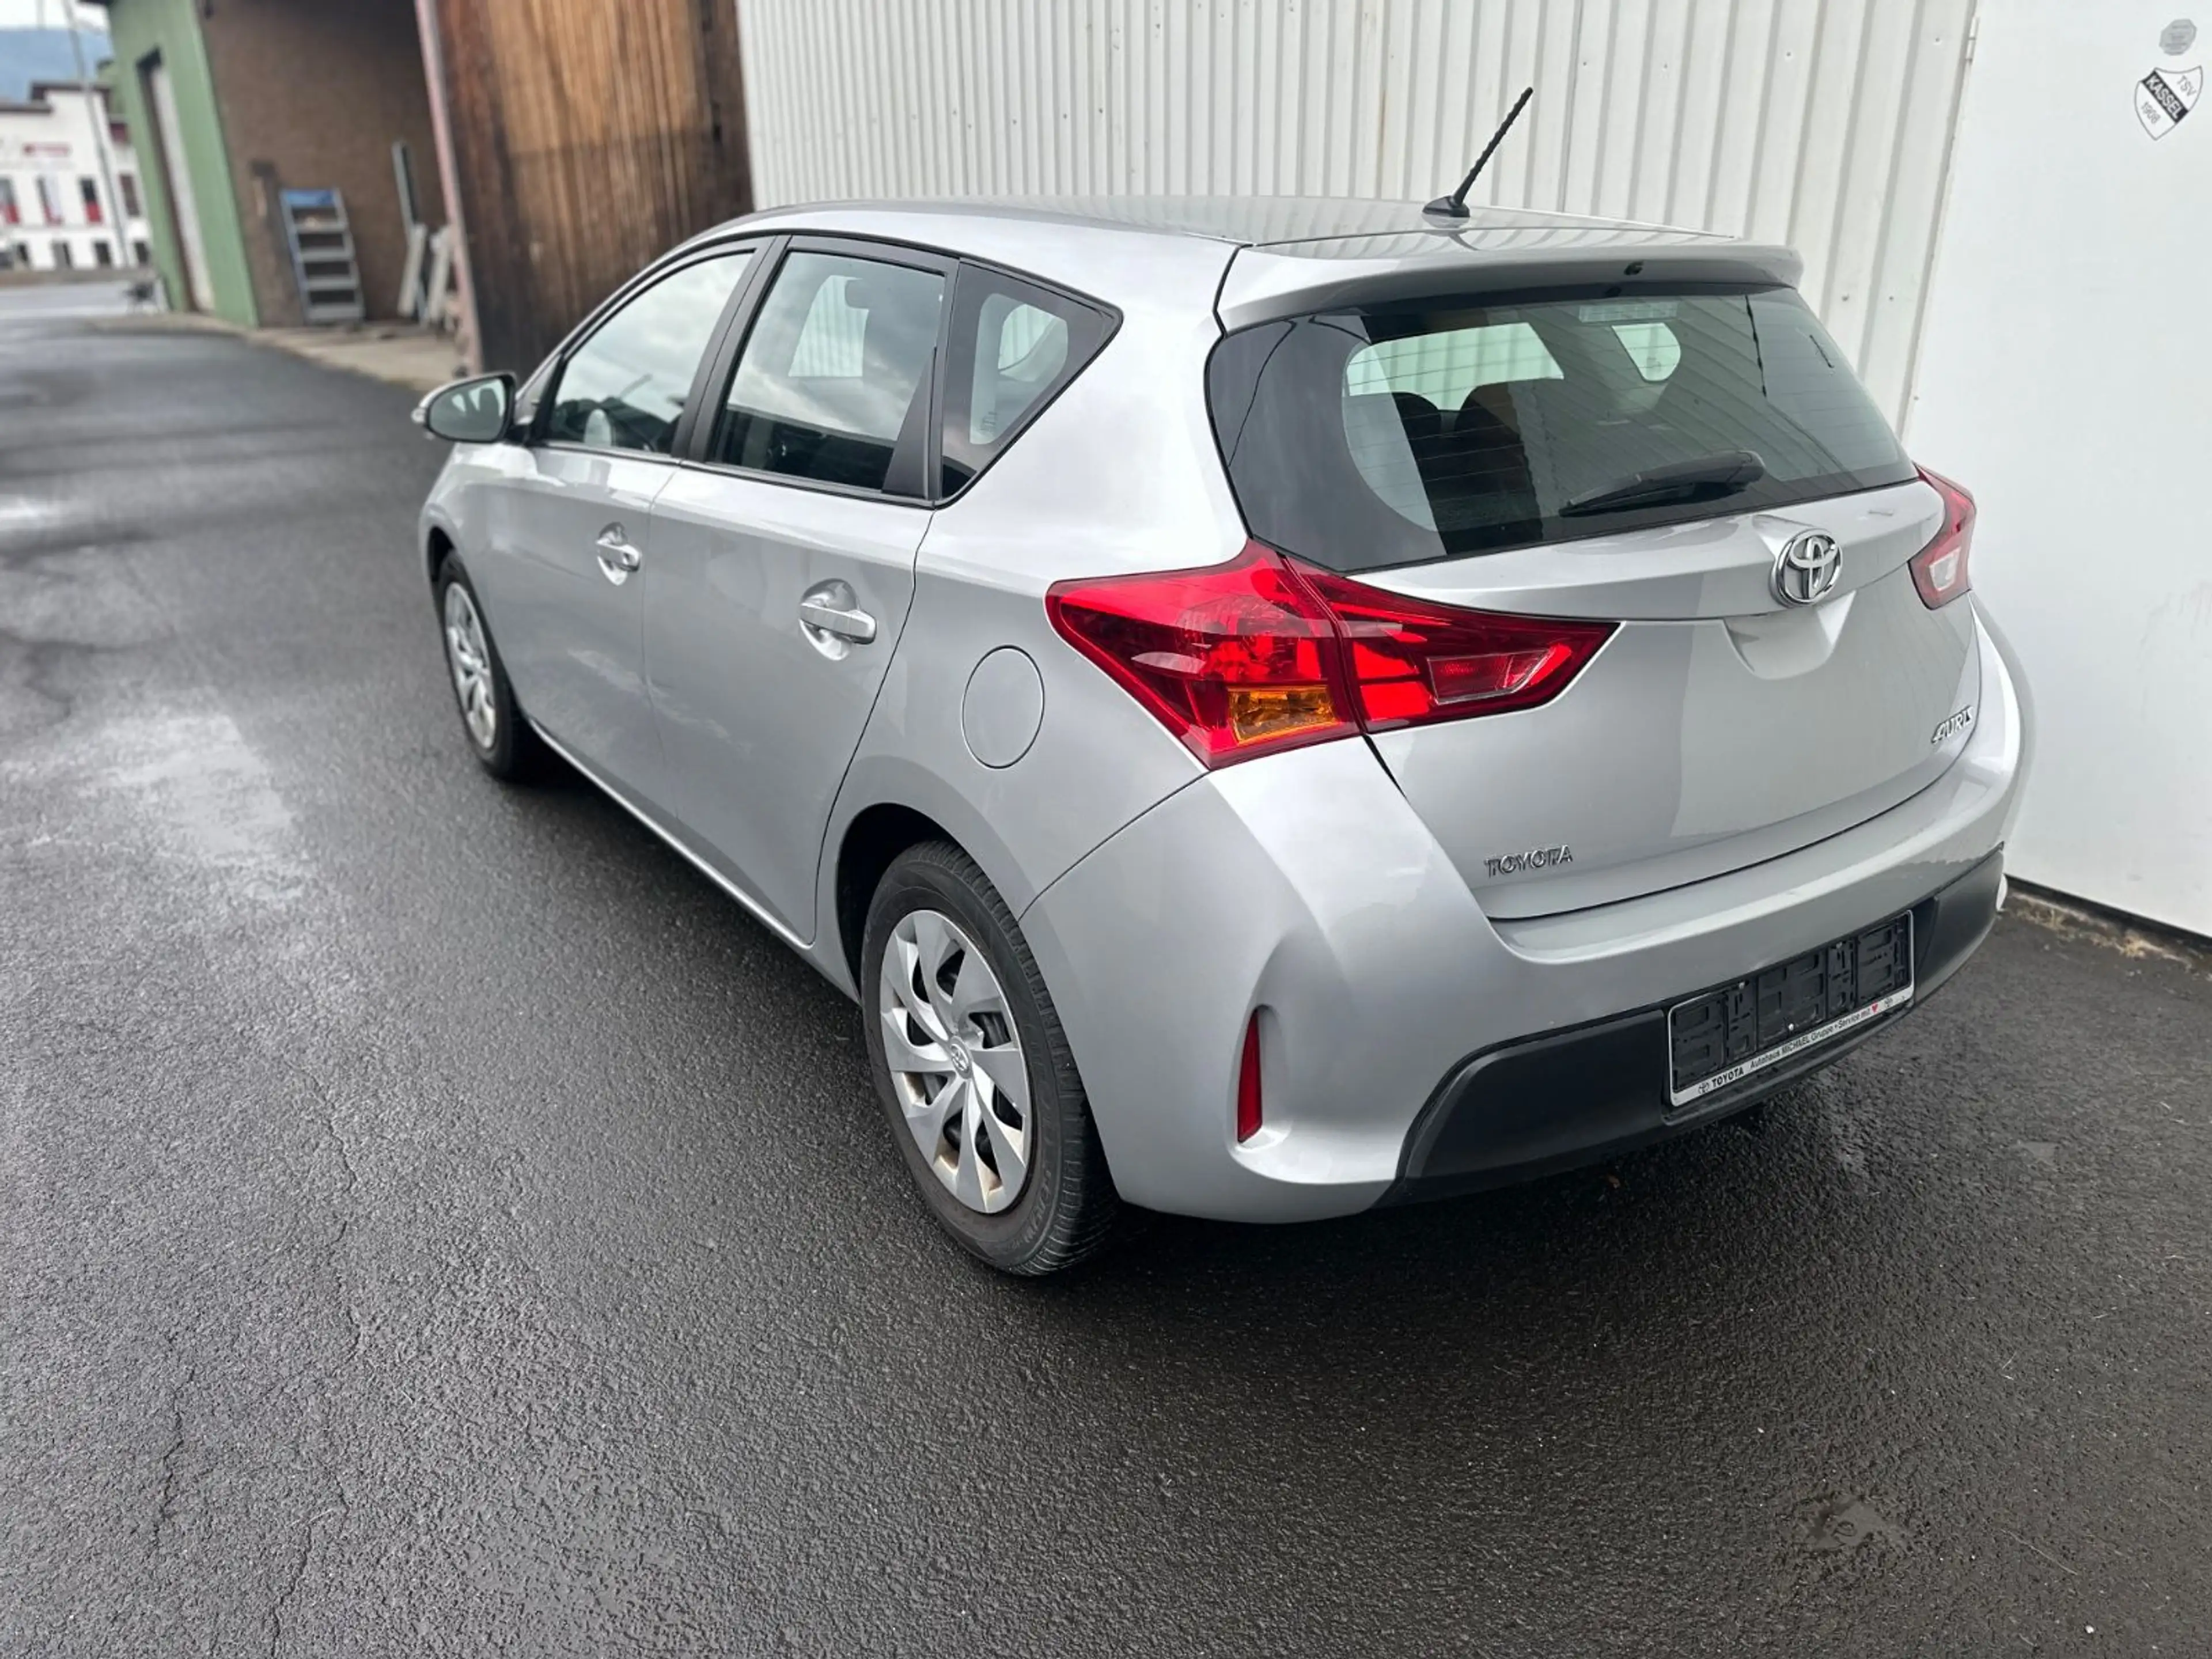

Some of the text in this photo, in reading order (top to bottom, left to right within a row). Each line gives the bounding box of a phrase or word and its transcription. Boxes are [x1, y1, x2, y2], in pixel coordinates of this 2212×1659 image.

[2145, 75, 2184, 119] KASSEL
[2176, 75, 2198, 97] TSV
[1931, 705, 1974, 744] AURIS
[1484, 844, 1573, 878] TOYOTA
[1711, 1066, 1744, 1088] TOYOTA
[1750, 1050, 1781, 1069] Autohaus
[1782, 1036, 1810, 1053] MICHAEL
[1838, 1013, 1860, 1029] Service
